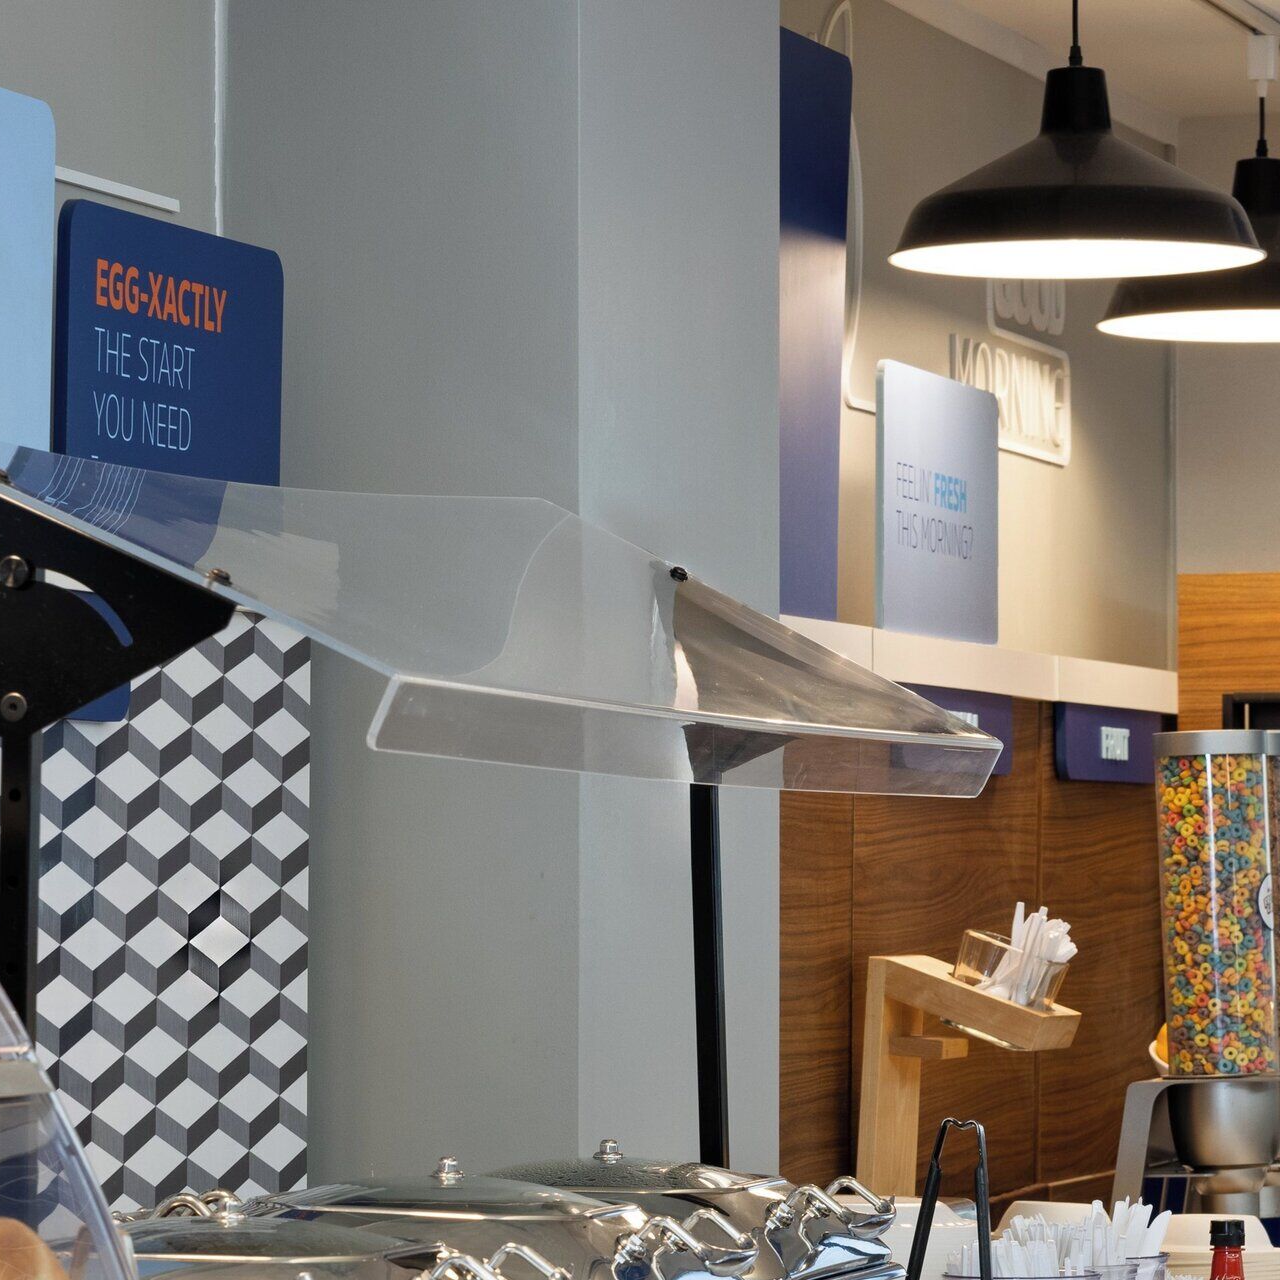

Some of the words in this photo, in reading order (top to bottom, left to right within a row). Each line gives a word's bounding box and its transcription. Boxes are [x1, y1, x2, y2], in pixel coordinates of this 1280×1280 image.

[95, 258, 228, 334] EGG-XACTLY
[94, 326, 133, 379] THE
[137, 336, 196, 391] START
[92, 390, 135, 442] YOU
[141, 400, 192, 452] NEED
[934, 472, 968, 514] FRESH
[896, 508, 919, 549] THIS
[921, 515, 975, 561] MORNING?
